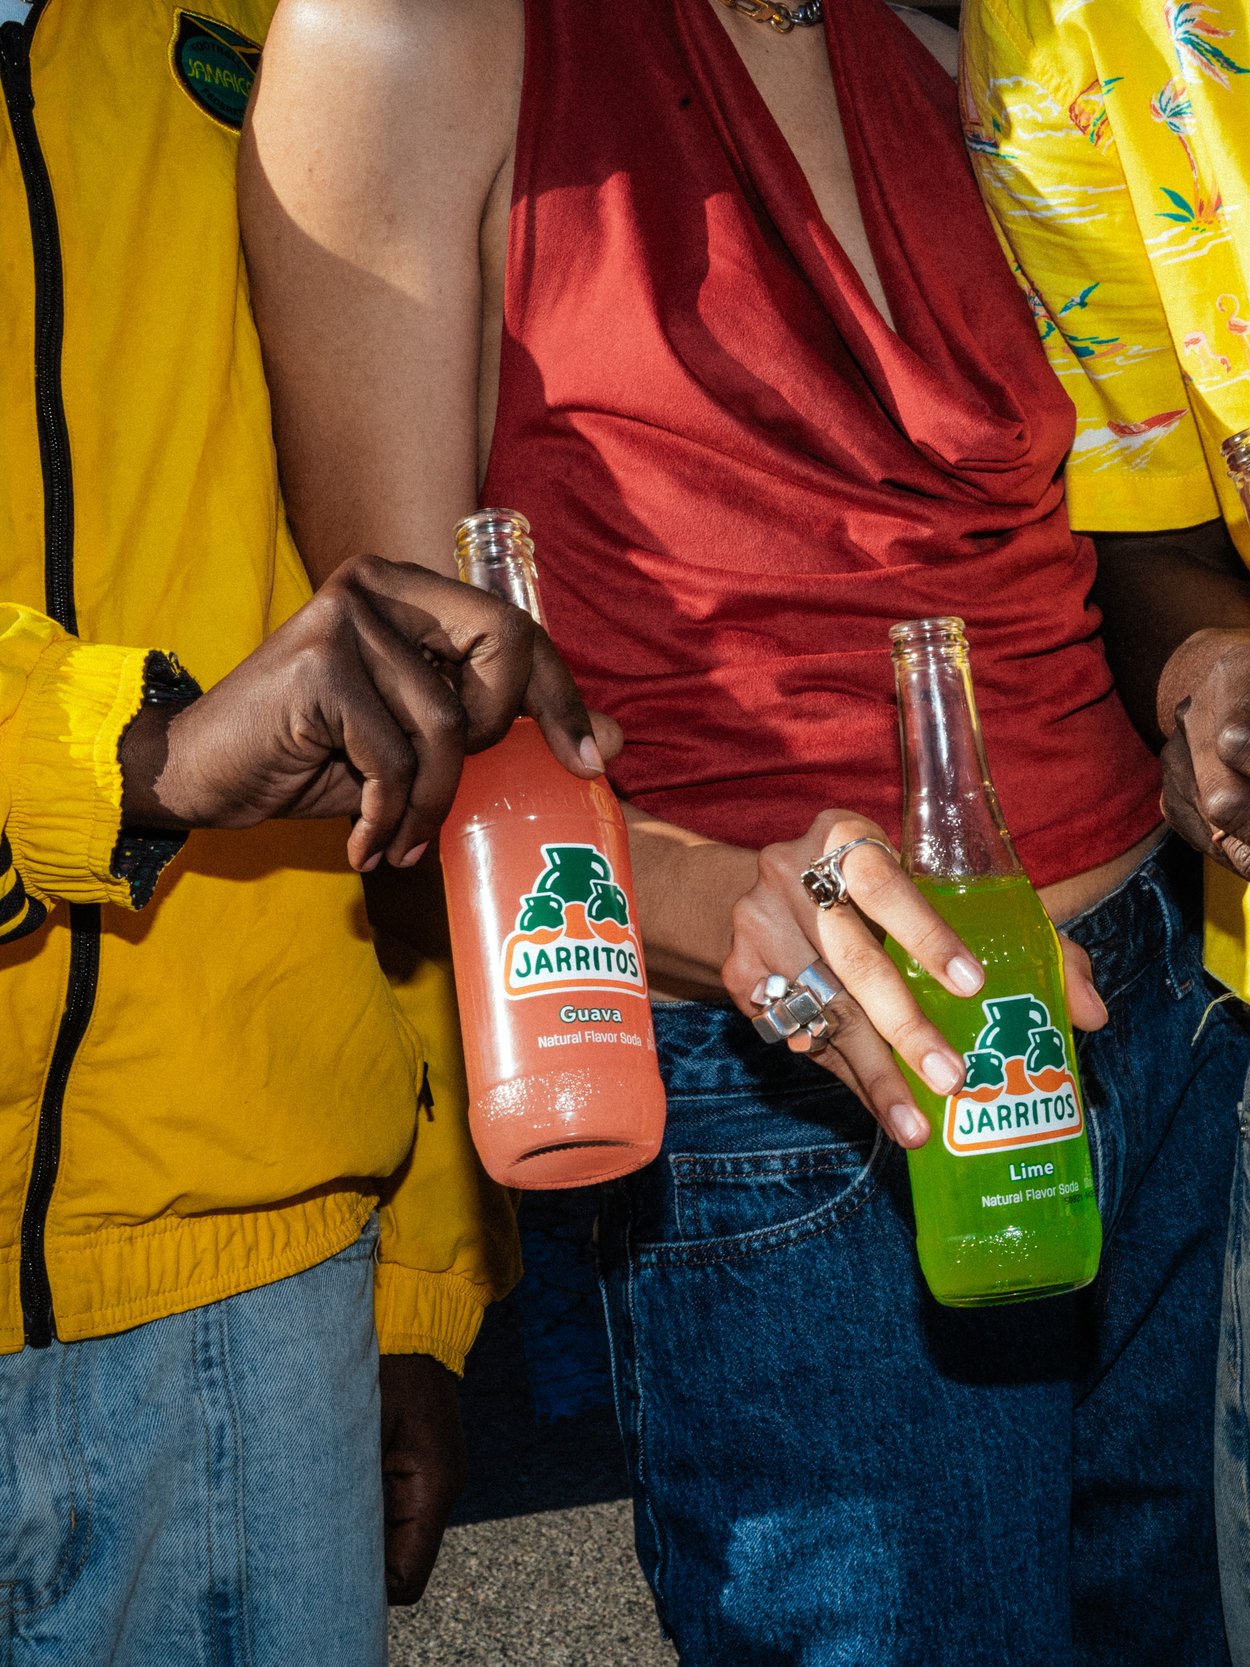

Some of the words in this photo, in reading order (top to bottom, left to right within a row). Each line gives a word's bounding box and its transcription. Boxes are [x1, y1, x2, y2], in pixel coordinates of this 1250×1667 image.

[515, 945, 639, 979] JARRITOS
[559, 1003, 623, 1024] Guava
[537, 1030, 583, 1049] Natural
[585, 1030, 618, 1044] Flavor
[620, 1033, 643, 1047] Soda
[959, 1093, 1076, 1135] JARRITOS
[1009, 1162, 1055, 1182] Lime
[981, 1190, 1024, 1208] Natural
[1025, 1185, 1057, 1202] Flavor
[1058, 1180, 1080, 1196] Soda
